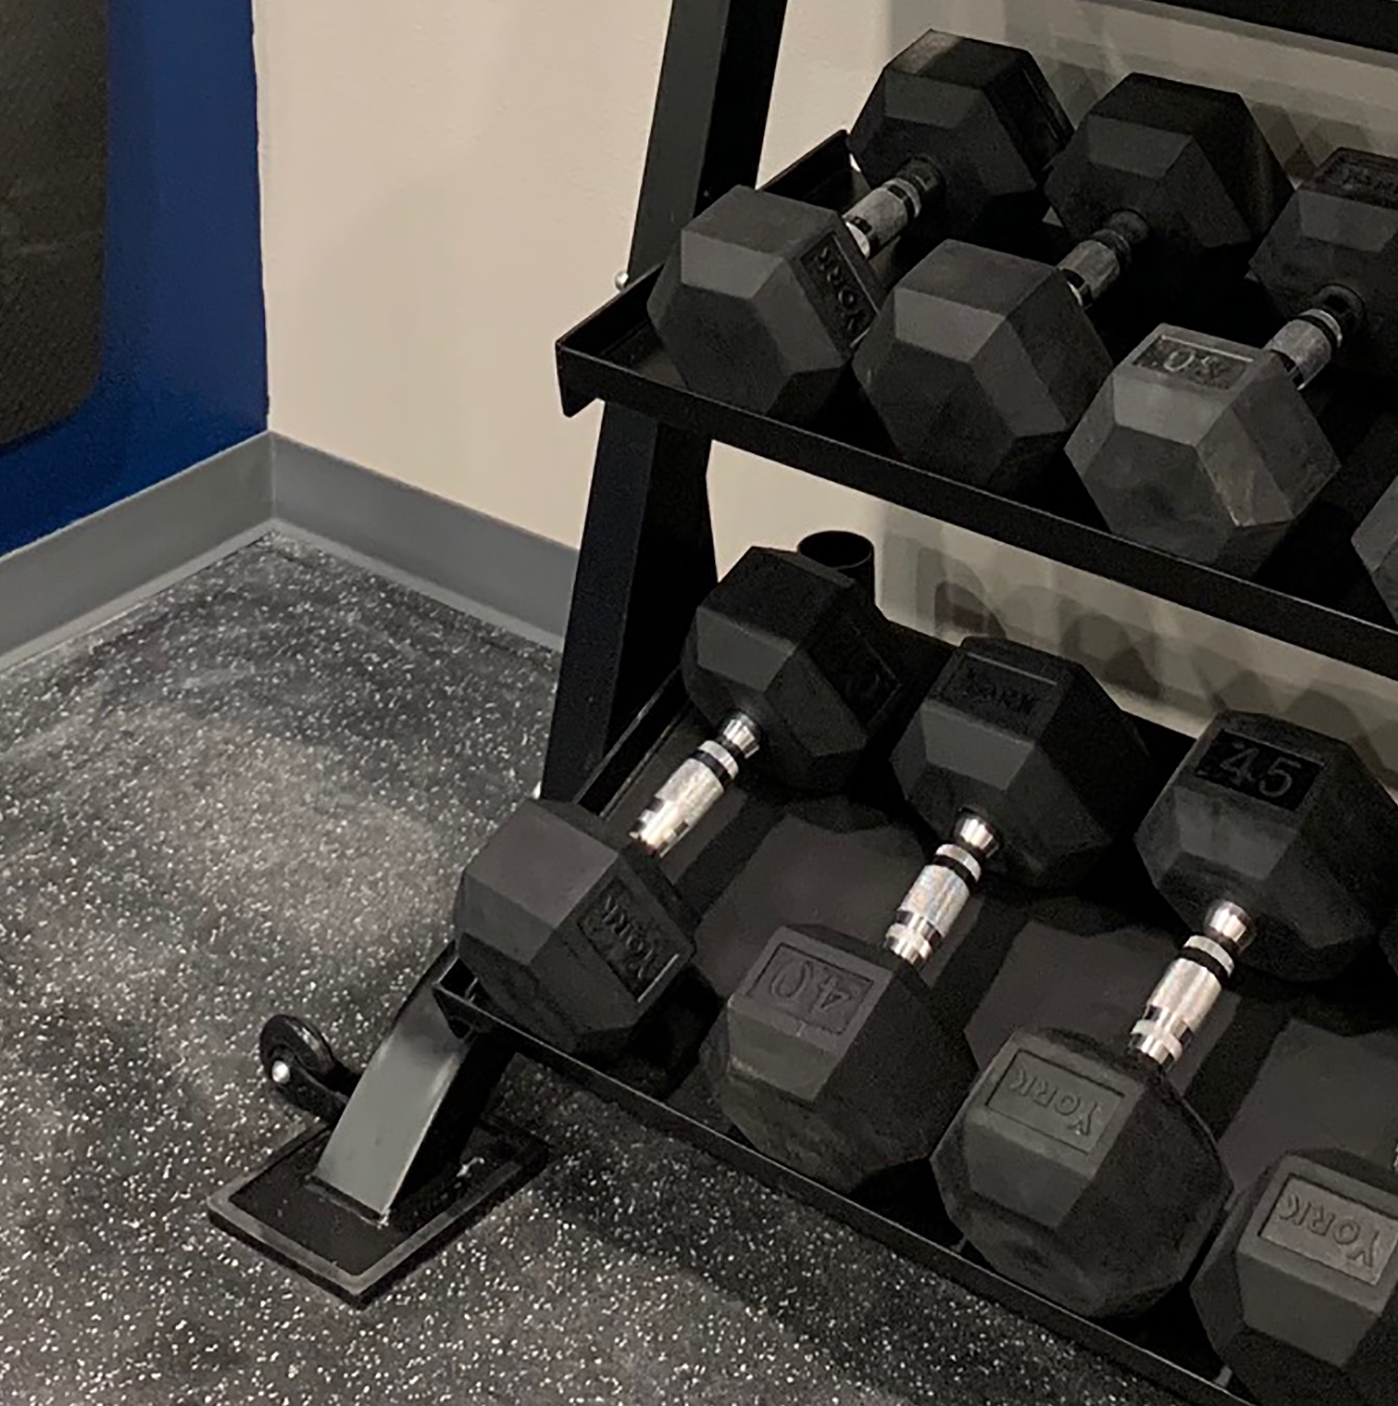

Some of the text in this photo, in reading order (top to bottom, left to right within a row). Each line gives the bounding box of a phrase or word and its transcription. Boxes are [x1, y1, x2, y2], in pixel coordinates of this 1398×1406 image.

[1218, 744, 1304, 800] 45
[599, 892, 666, 982] YORK
[767, 963, 853, 1020] 40
[1010, 1063, 1103, 1138] YORK
[1277, 1194, 1380, 1269] YORK
